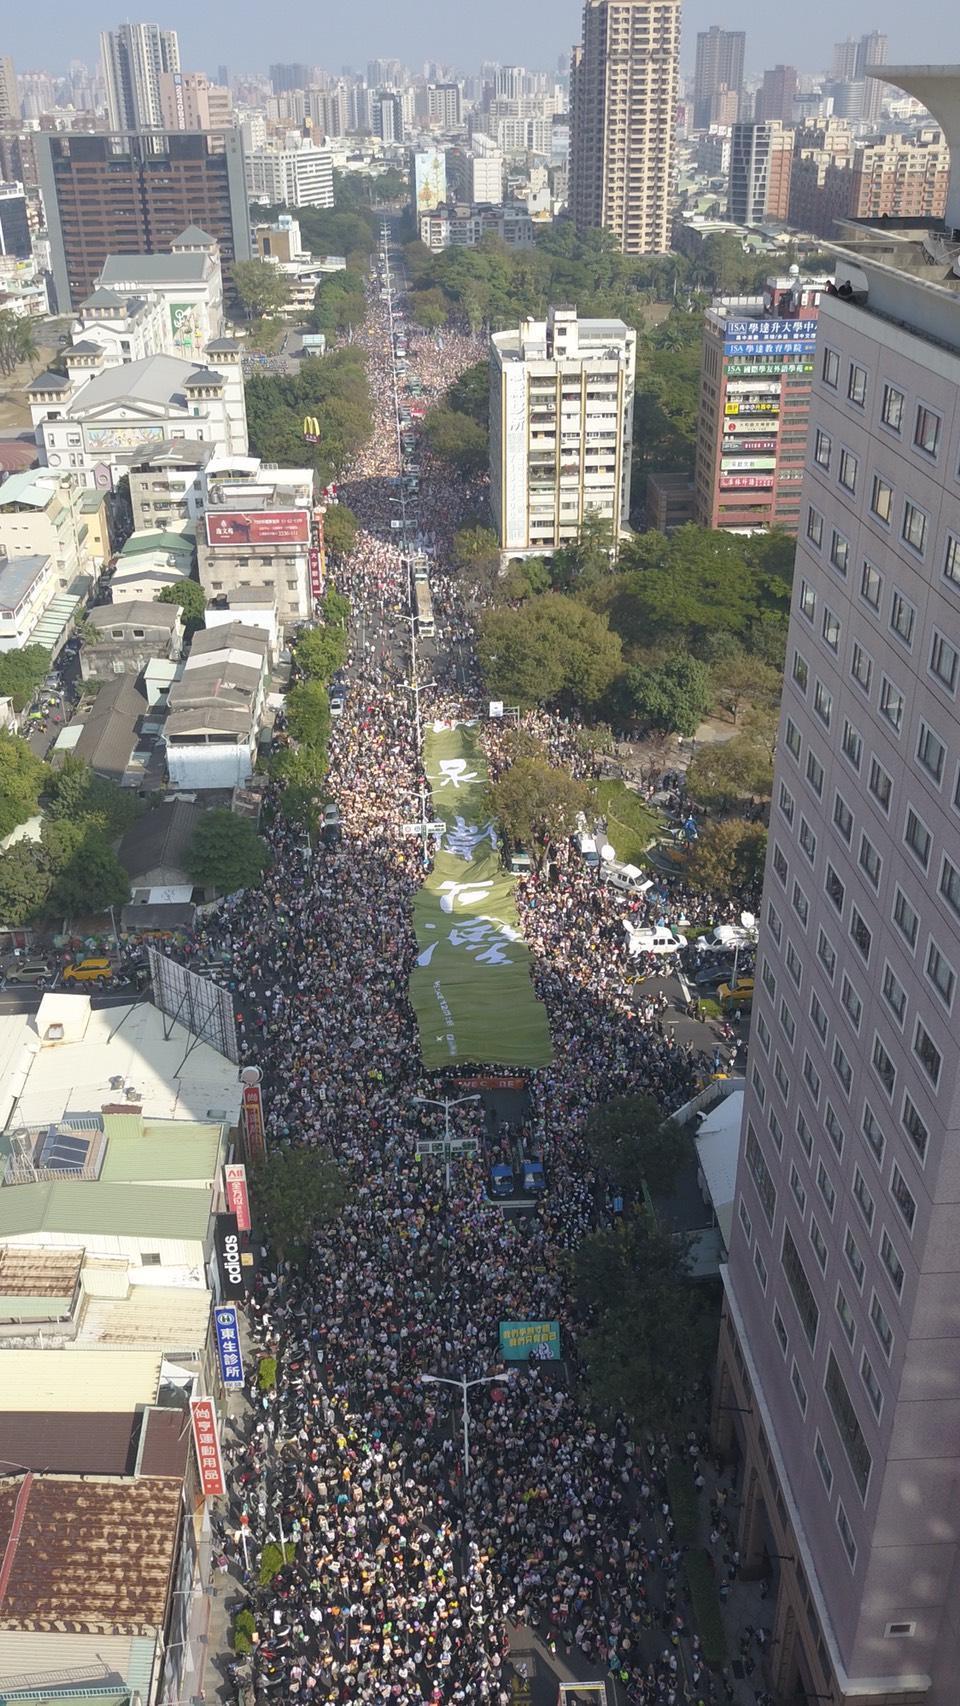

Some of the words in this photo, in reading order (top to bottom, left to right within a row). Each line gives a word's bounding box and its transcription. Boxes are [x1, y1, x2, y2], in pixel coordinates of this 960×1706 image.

[730, 323, 745, 331] ISA
[223, 1235, 242, 1284] adidas
[220, 1328, 240, 1378] 東生診所
